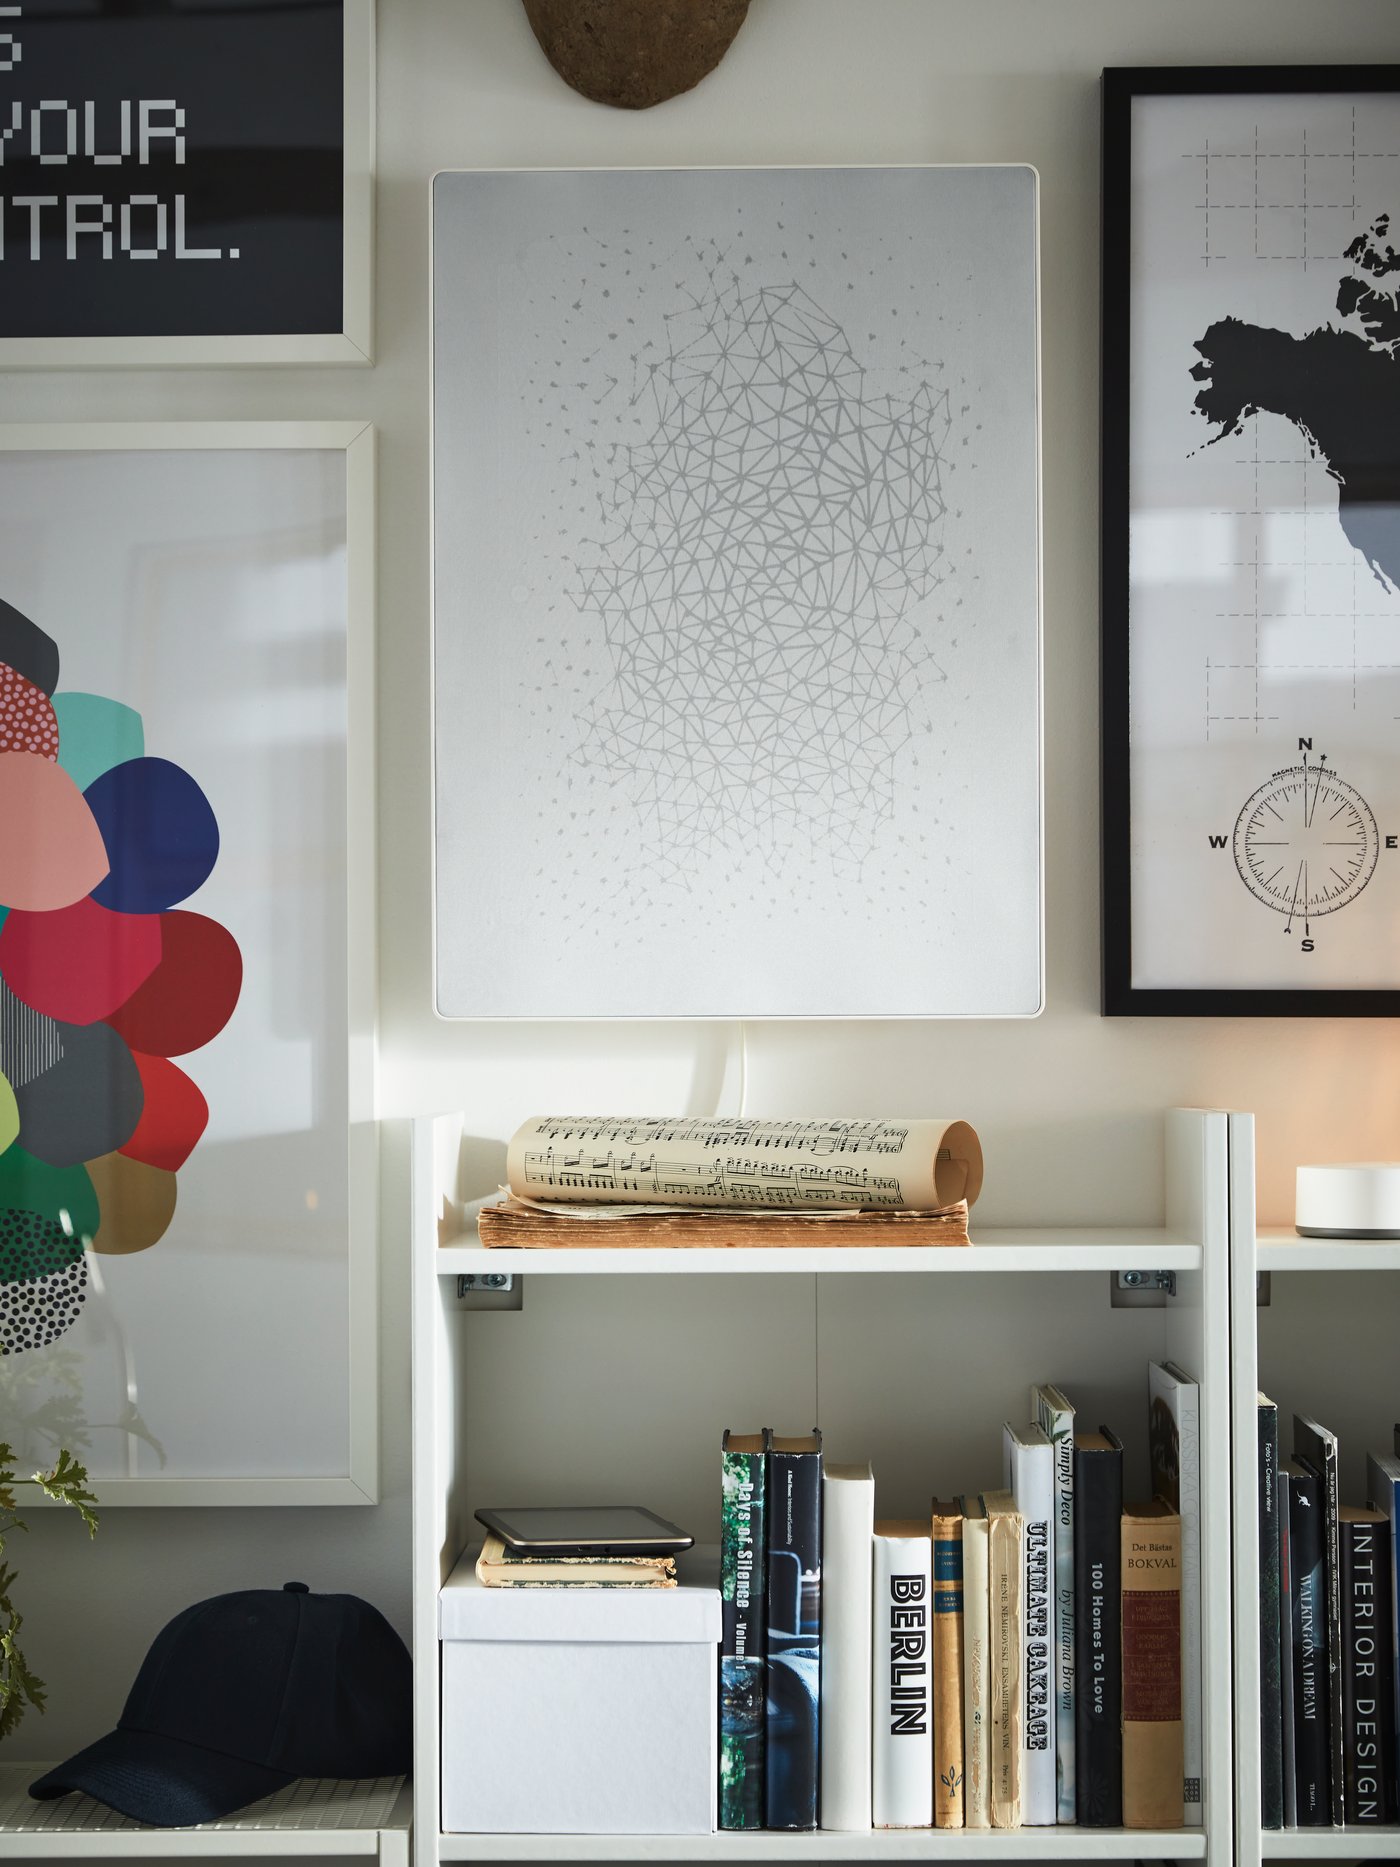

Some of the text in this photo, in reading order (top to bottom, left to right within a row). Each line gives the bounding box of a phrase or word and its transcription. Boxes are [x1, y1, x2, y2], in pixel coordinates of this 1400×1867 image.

[1298, 737, 1313, 751] N
[1271, 765, 1337, 778] MAGNETIC COMPASS
[1208, 835, 1228, 849] W
[1385, 835, 1398, 849] E
[1301, 939, 1315, 952] S
[1181, 1408, 1198, 1496] KLASSISKA
[1265, 1442, 1273, 1462] Foto's
[1057, 1436, 1075, 1526] Simply Deco
[1265, 1468, 1273, 1495] Creative
[736, 1482, 755, 1521] Days
[737, 1527, 753, 1544] of
[1132, 1543, 1147, 1551] Det
[736, 1550, 754, 1608] Silence
[1128, 1558, 1177, 1569] BOKVAL
[735, 1623, 747, 1661] Volume
[1026, 1520, 1049, 1751] ULTIMATE CAKEAGE
[1058, 1589, 1076, 1711] by Juliana Brown
[1091, 1562, 1106, 1714] 100 Homes To Love
[1300, 1574, 1317, 1720] WALKING ON A DREAM
[890, 1574, 927, 1736] BERLIN
[1352, 1523, 1378, 1819] INTERIOR DESIGN
